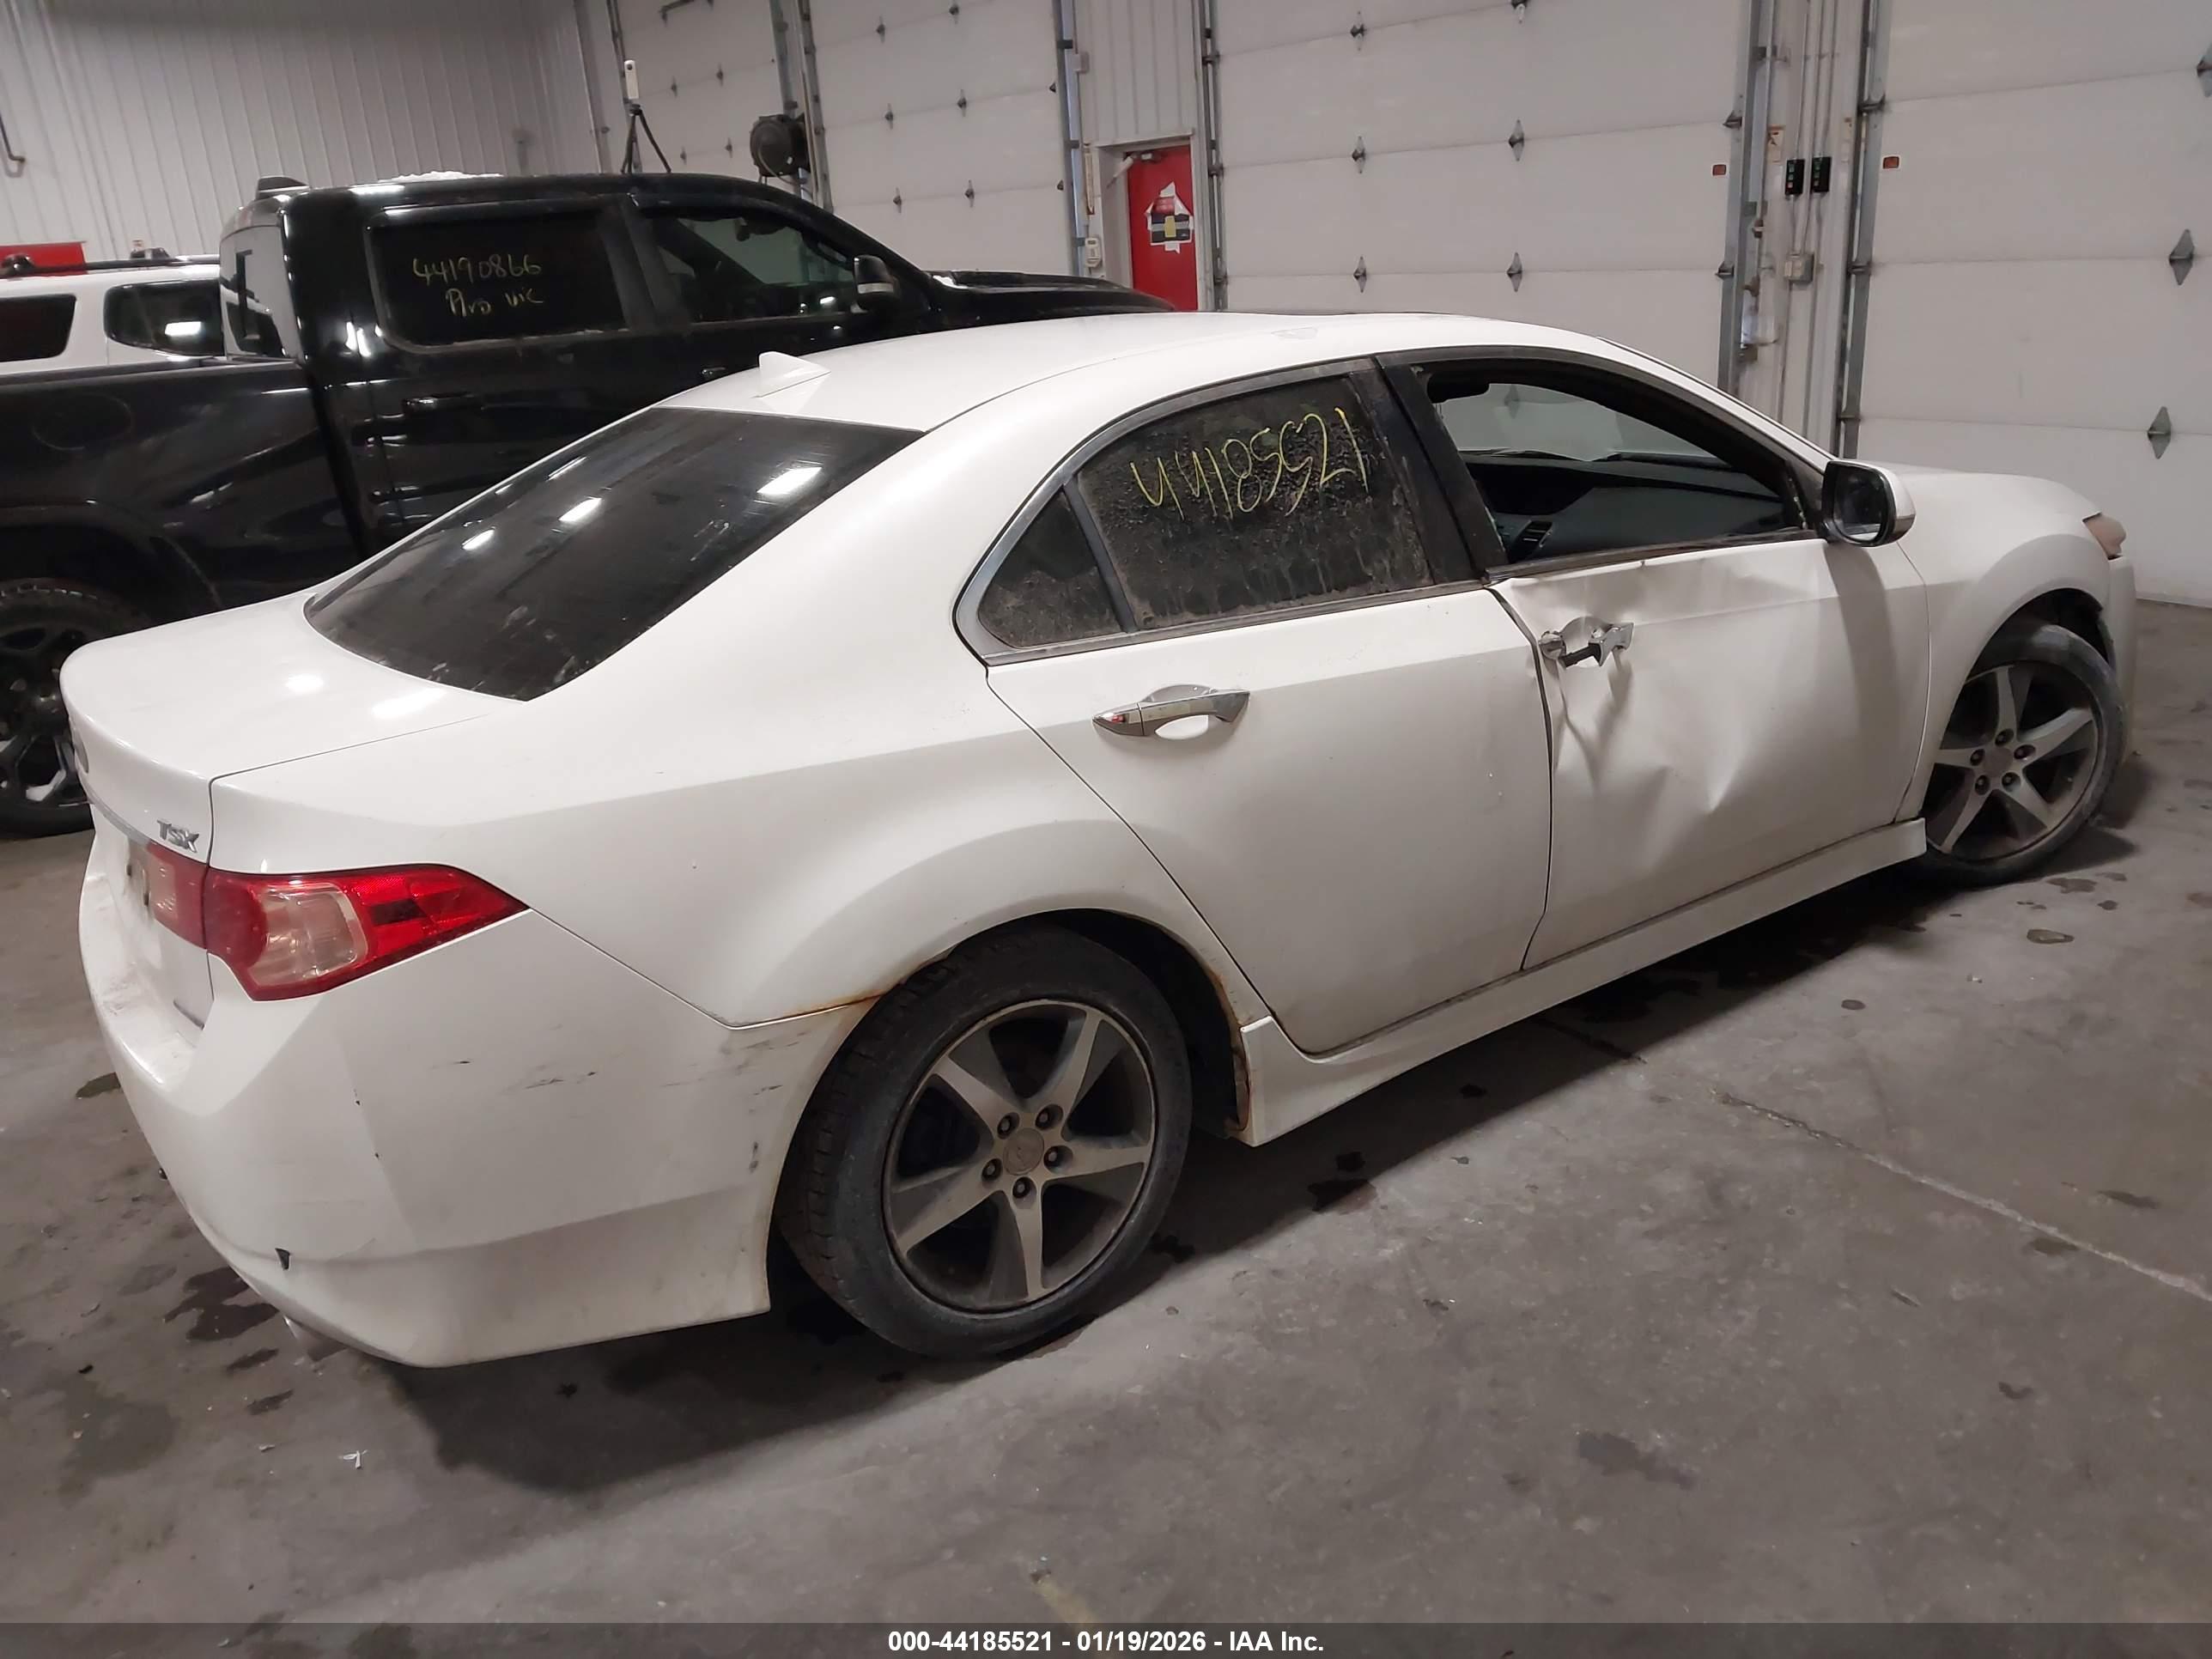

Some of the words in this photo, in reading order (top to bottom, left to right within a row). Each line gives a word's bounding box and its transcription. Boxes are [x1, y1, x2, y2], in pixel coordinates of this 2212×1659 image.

[412, 253, 543, 286] 44190866
[1129, 406, 1370, 521] 44185521
[156, 818, 200, 854] TSX
